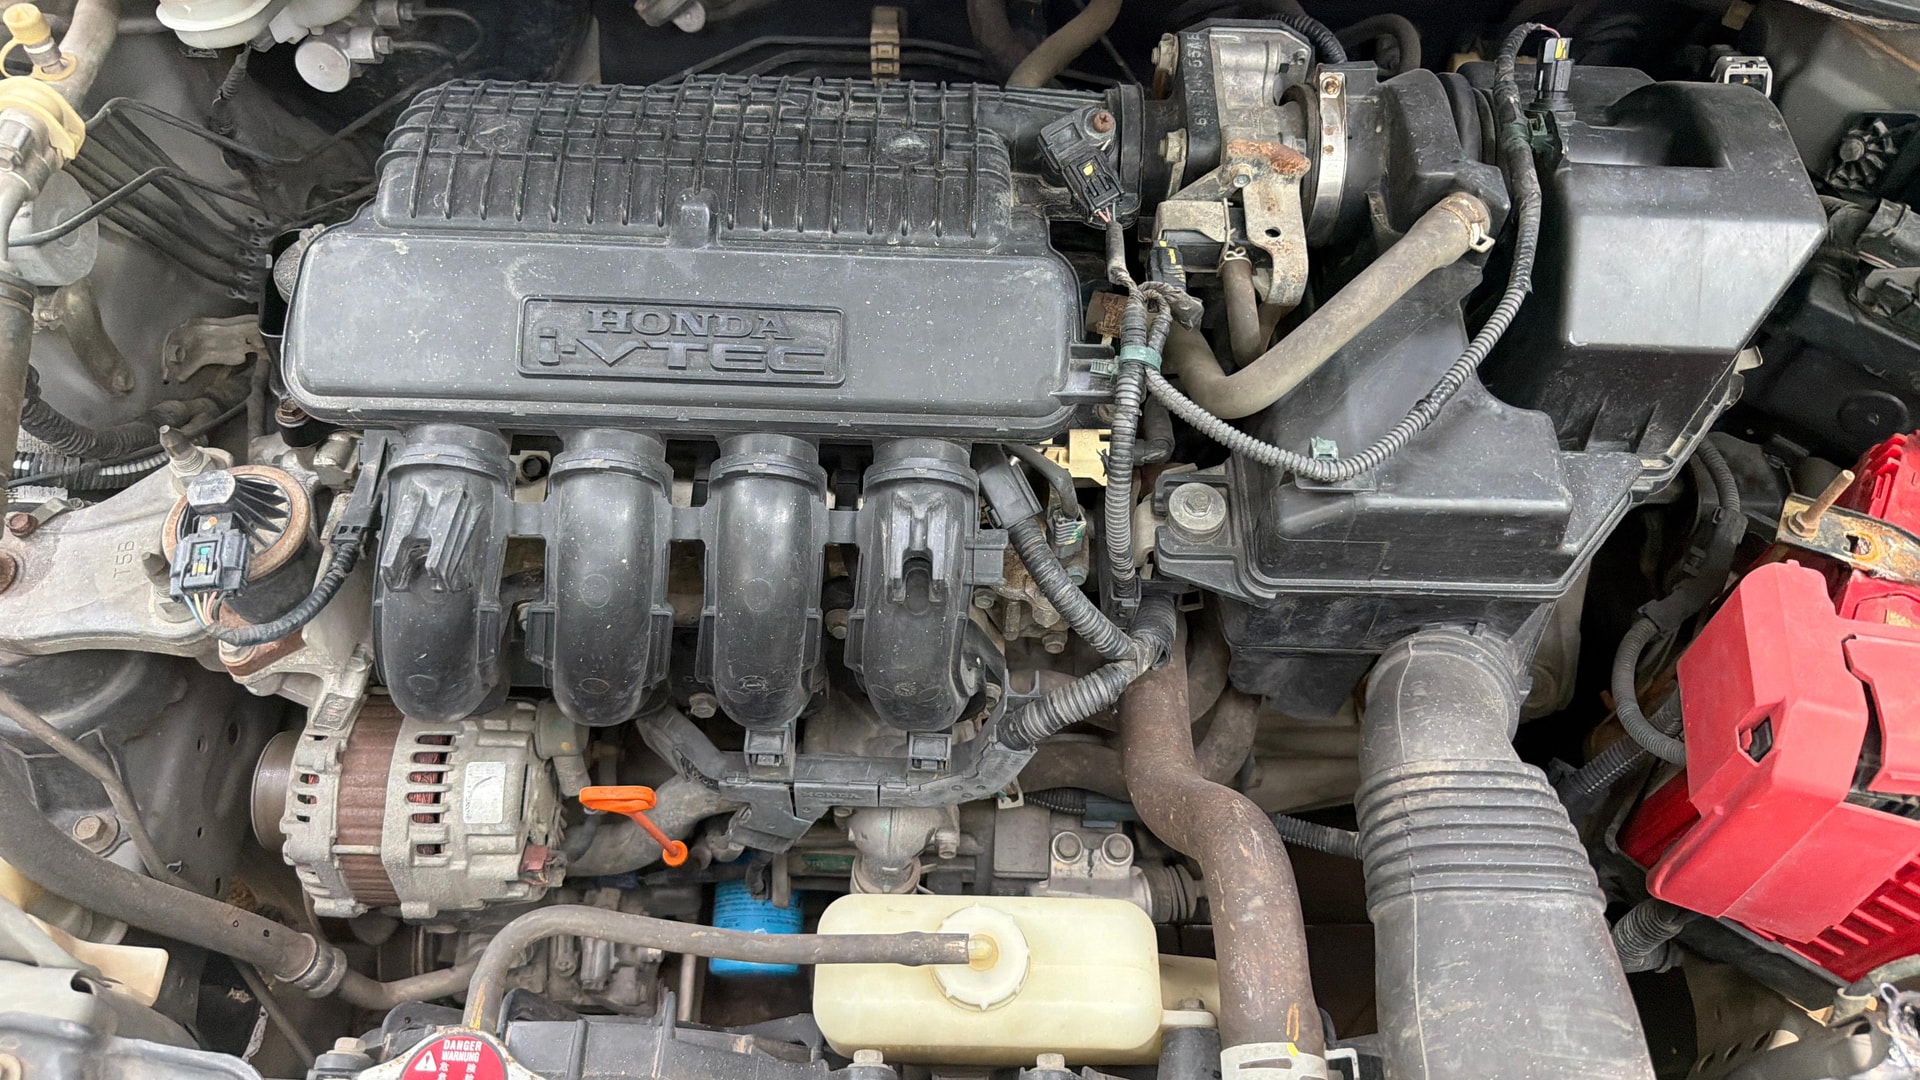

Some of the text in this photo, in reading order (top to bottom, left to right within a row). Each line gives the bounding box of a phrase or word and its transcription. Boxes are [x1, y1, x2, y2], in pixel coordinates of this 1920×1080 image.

[588, 307, 795, 341] HONDA
[538, 327, 826, 375] i-VTEC
[441, 1050, 481, 1063] WARNUNG
[443, 1039, 483, 1052] DANGER
